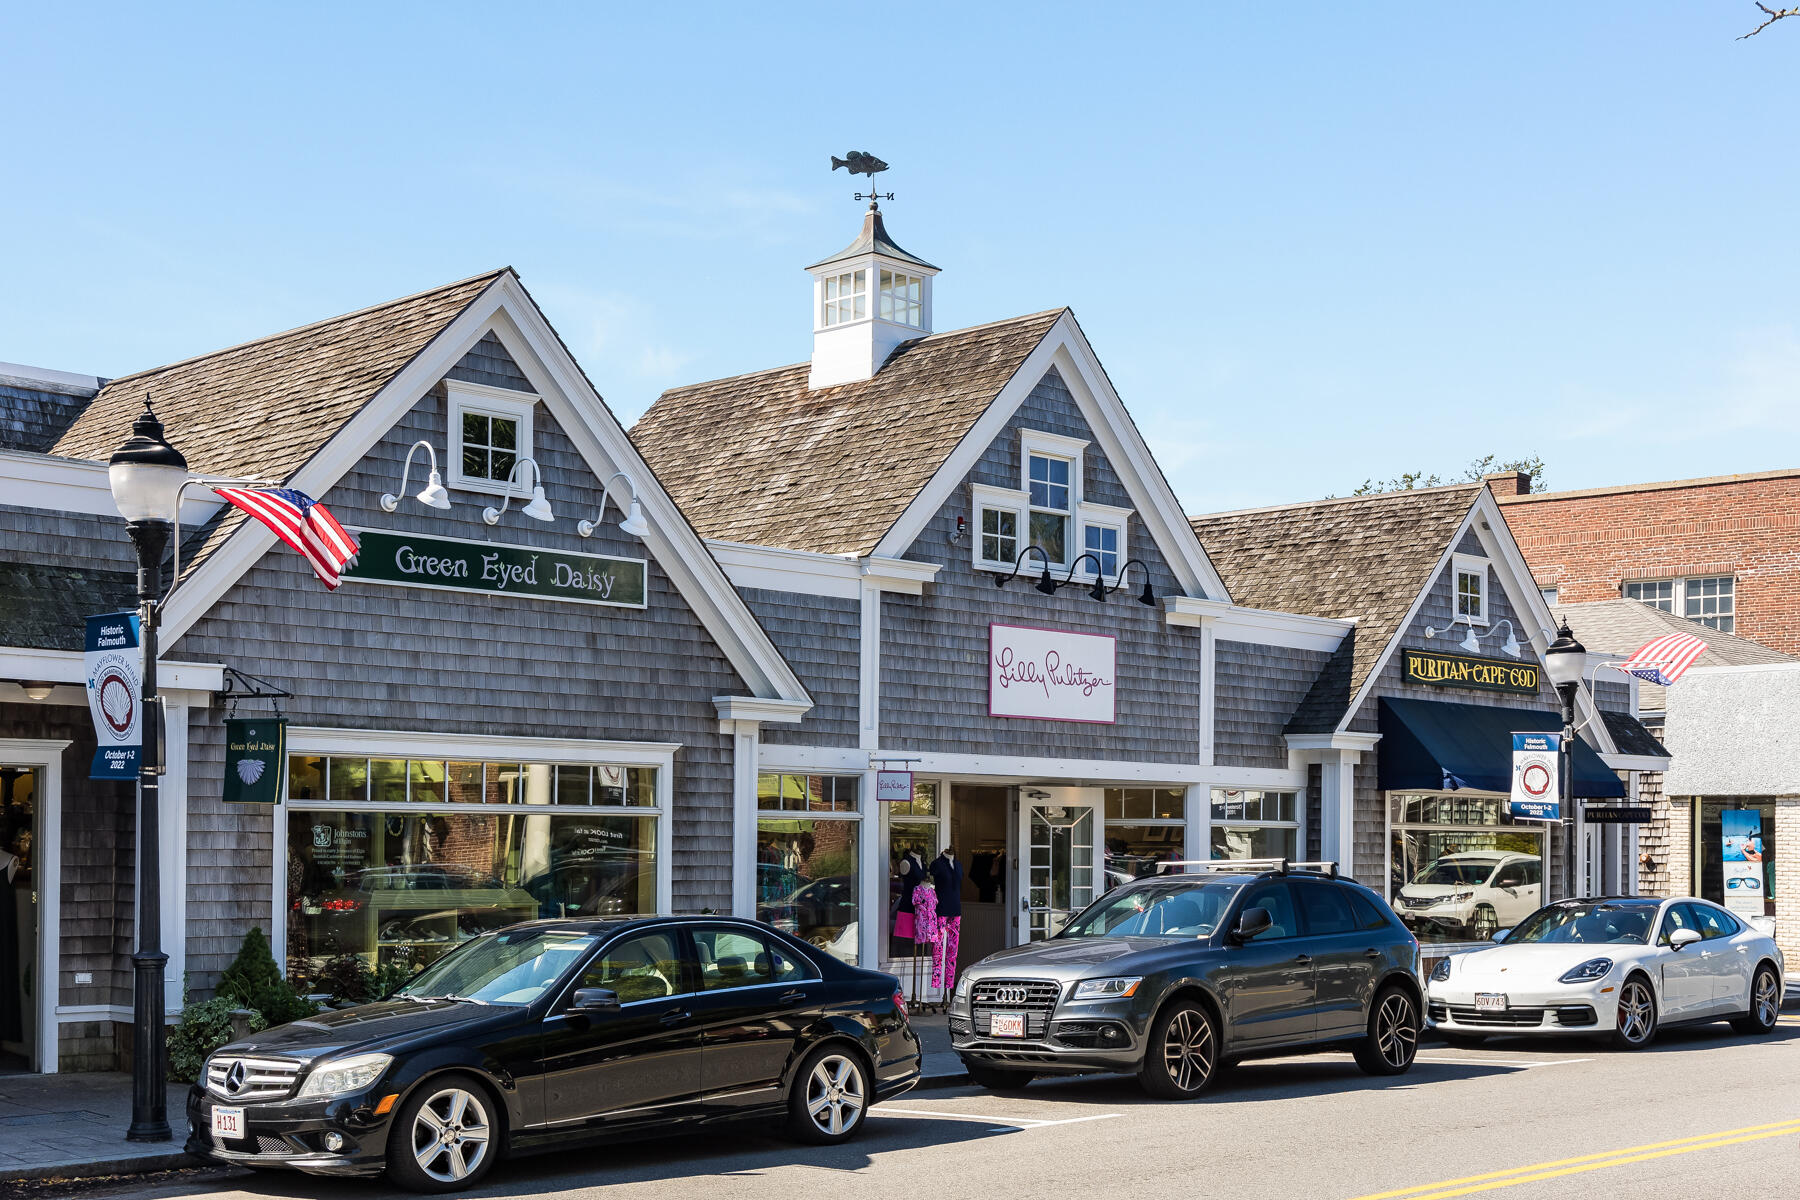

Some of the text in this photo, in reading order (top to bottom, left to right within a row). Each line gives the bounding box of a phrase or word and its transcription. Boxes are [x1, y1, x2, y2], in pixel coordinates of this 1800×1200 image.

[395, 545, 616, 599] Green Eyed Daisy
[101, 624, 124, 636] Historic
[97, 634, 126, 647] Falmouth
[92, 653, 139, 687] MAYFLOWER WIND
[995, 646, 1113, 699] Lilly Pulitzer
[1408, 656, 1536, 688] PURITAN CAPE COD
[104, 750, 135, 760] October 1-2
[110, 760, 126, 769] 2022
[334, 829, 367, 839] Johnstons
